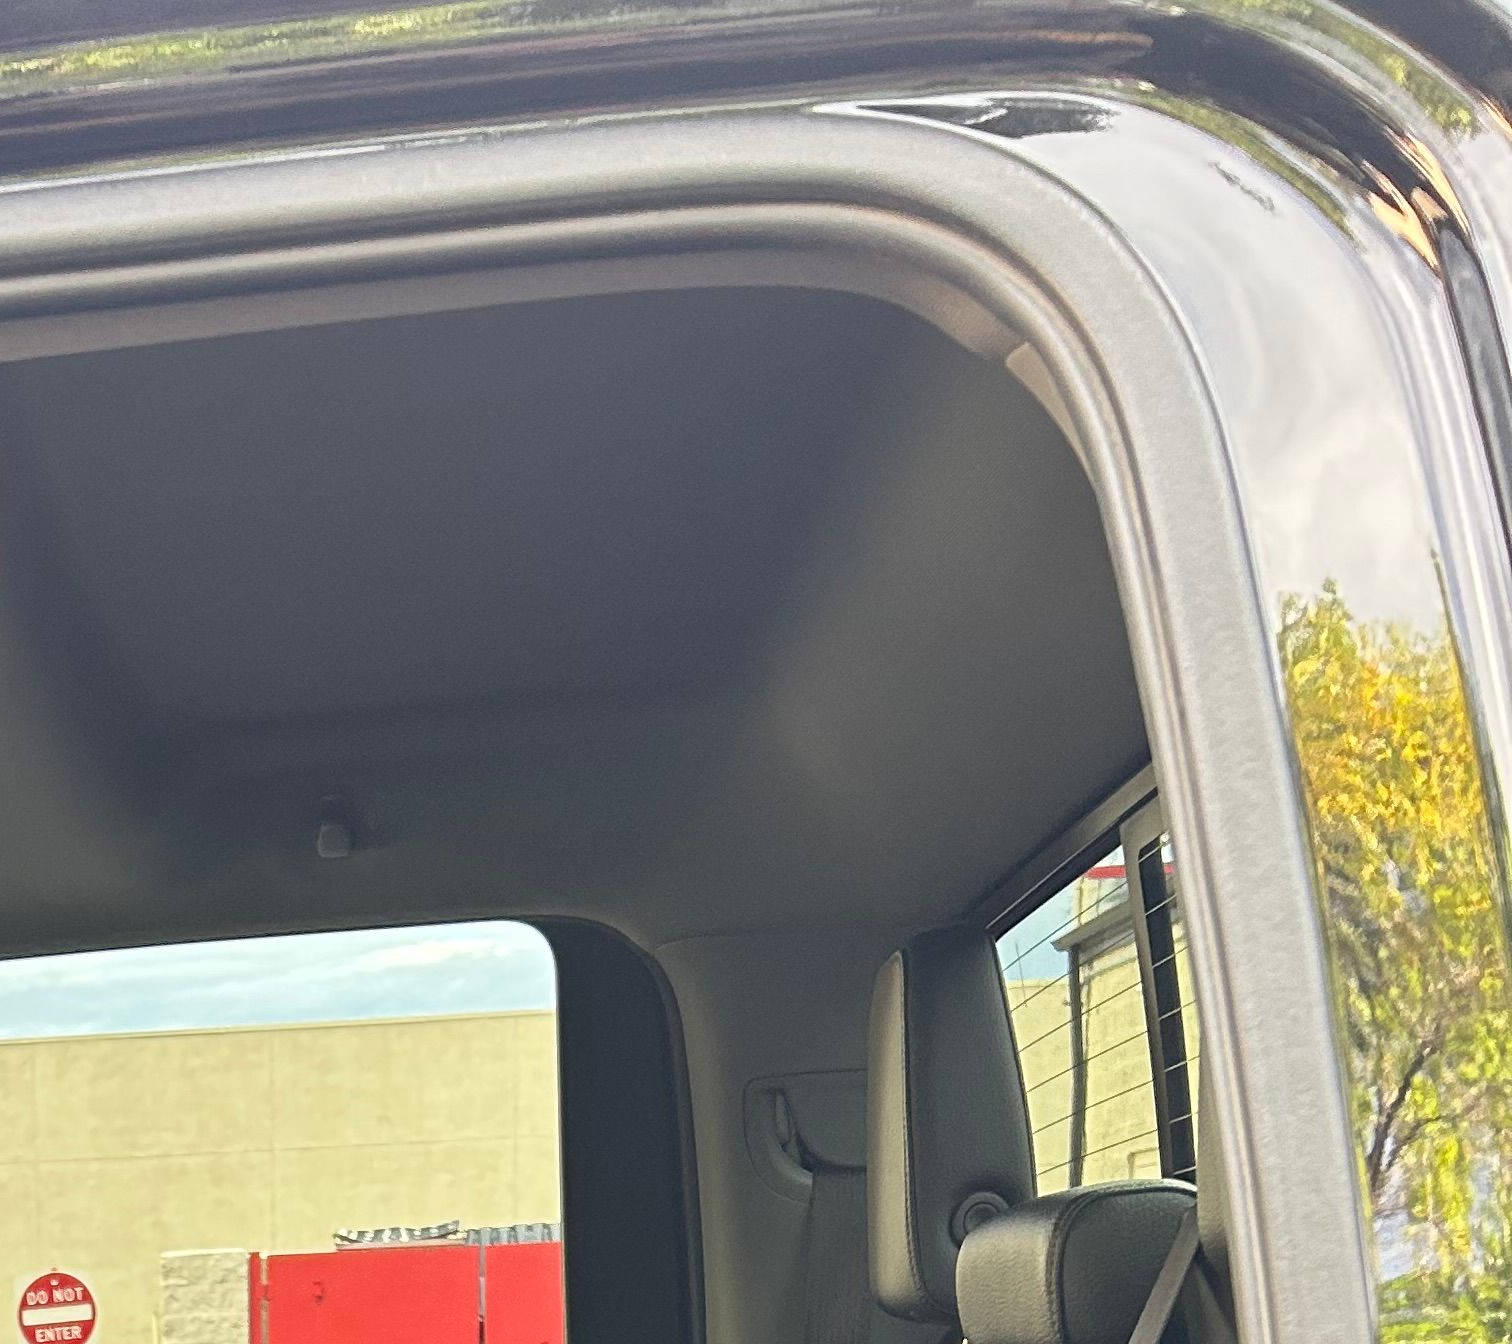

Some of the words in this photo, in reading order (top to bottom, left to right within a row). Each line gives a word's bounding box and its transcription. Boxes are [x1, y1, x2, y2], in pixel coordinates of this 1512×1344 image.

[26, 1290, 48, 1305] DO
[52, 1287, 84, 1302] NOT
[35, 1326, 82, 1343] ENTER
